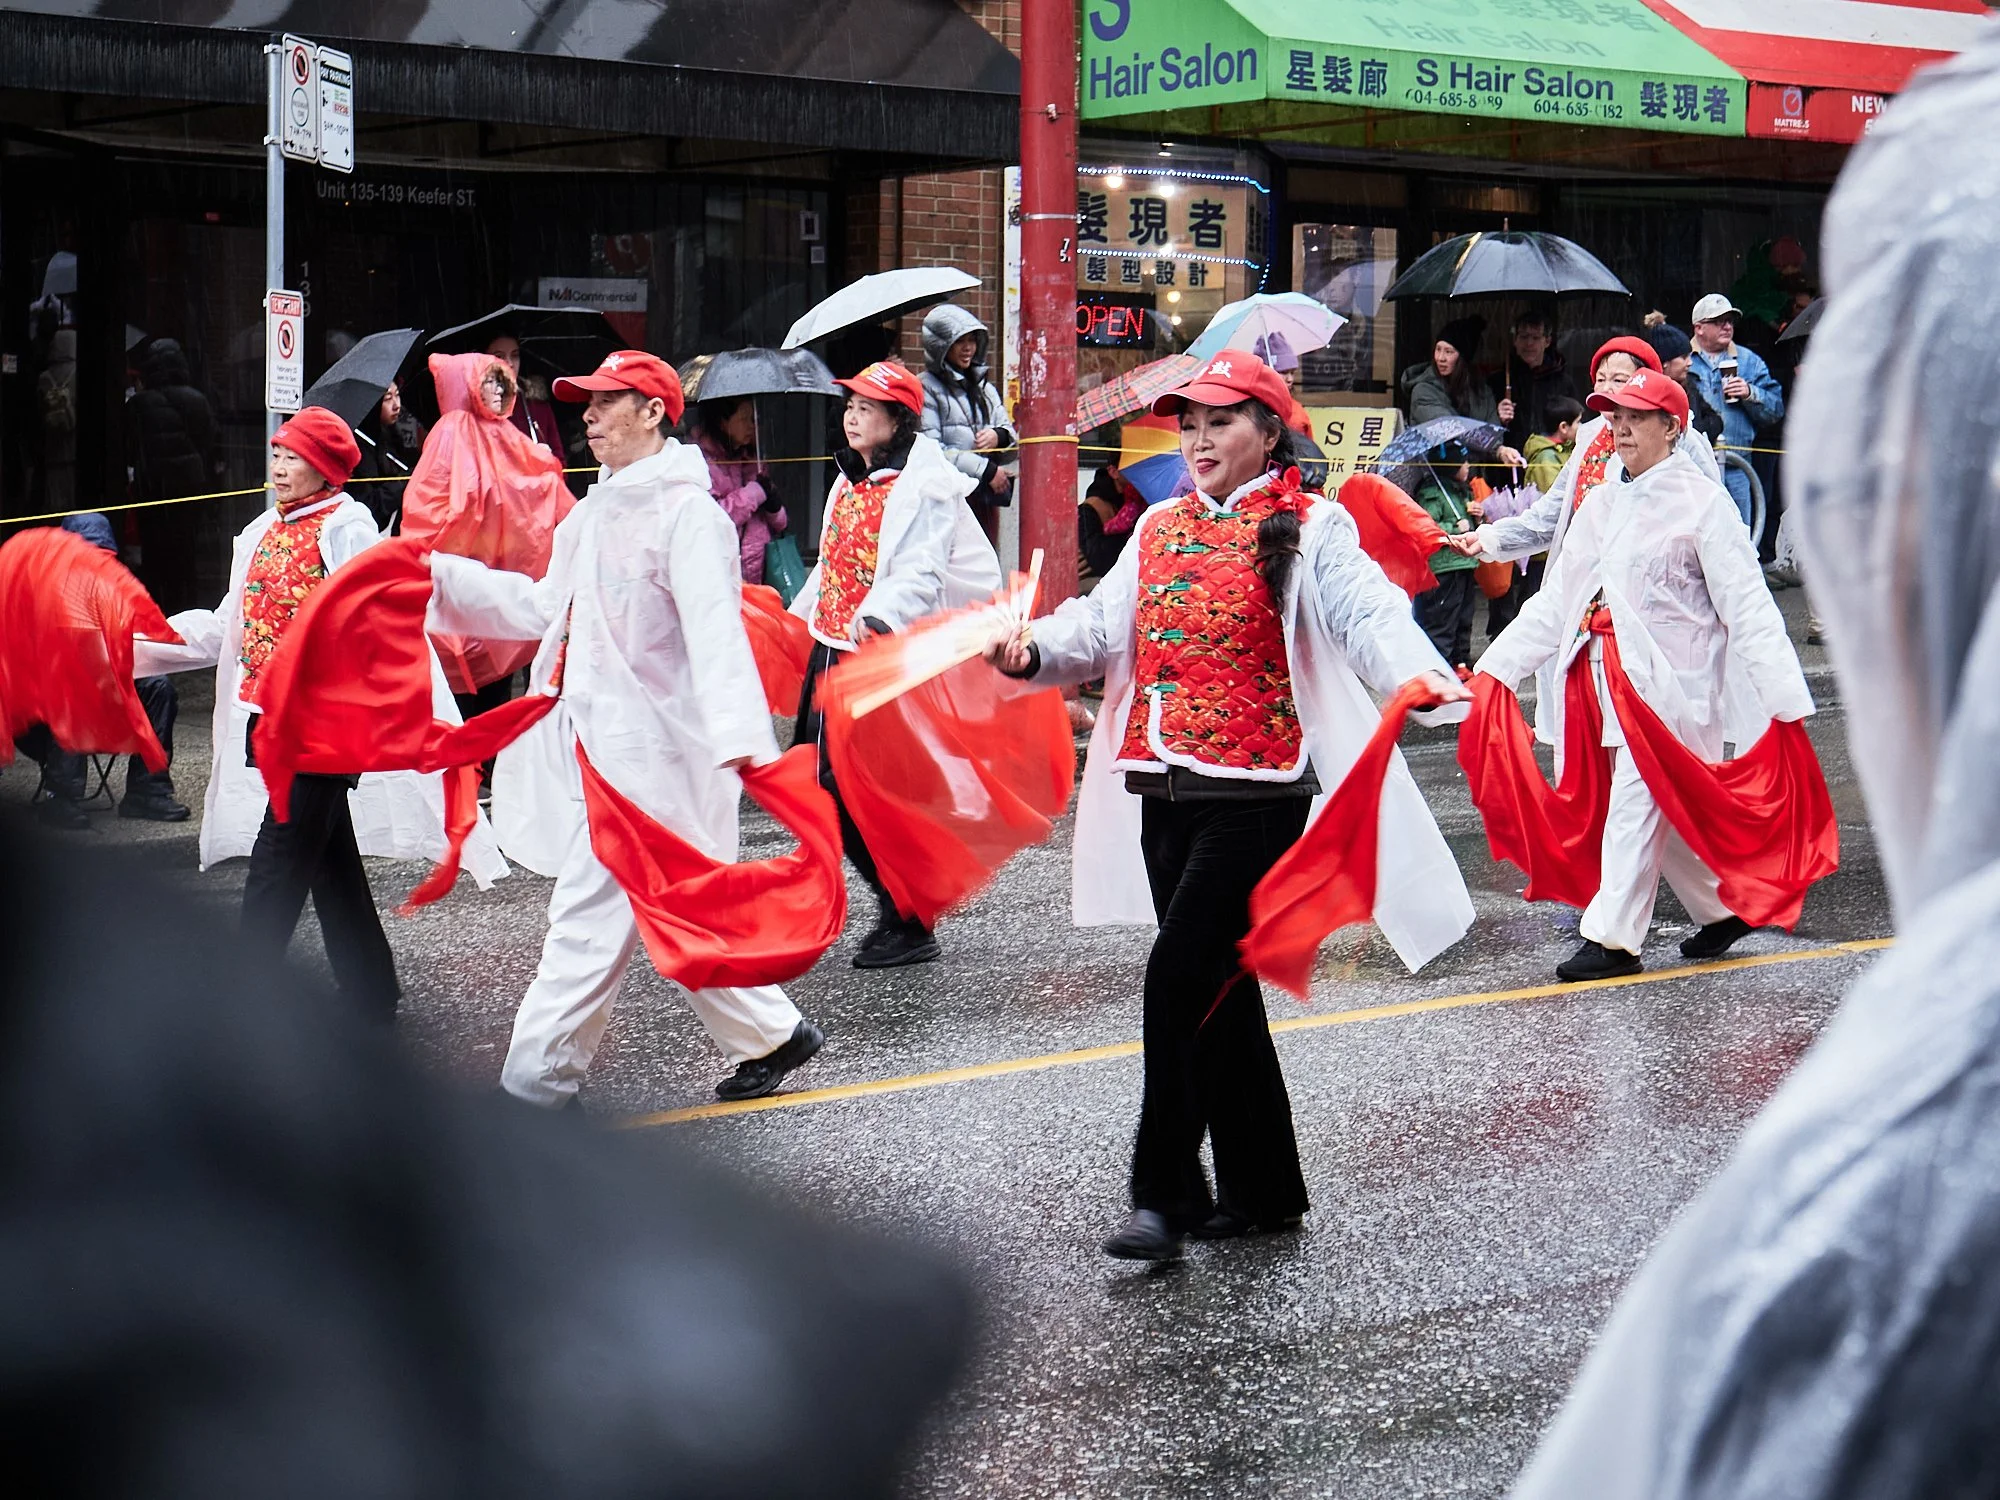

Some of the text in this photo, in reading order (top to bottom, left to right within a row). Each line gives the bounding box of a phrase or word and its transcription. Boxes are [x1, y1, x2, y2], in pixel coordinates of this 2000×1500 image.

[1090, 43, 1257, 100] Hair Salon
[1286, 49, 1389, 99] 星髮廊
[1416, 59, 1614, 101] S Hair Salon
[1640, 81, 1730, 124] 髮現者
[317, 180, 346, 199] Unit
[350, 183, 403, 203] 135-139
[408, 187, 453, 205] Keefer
[1078, 191, 1226, 249] 髮現者
[1086, 256, 1209, 287] 髮型設計
[1077, 304, 1144, 337] OPEN
[1325, 421, 1344, 445] S
